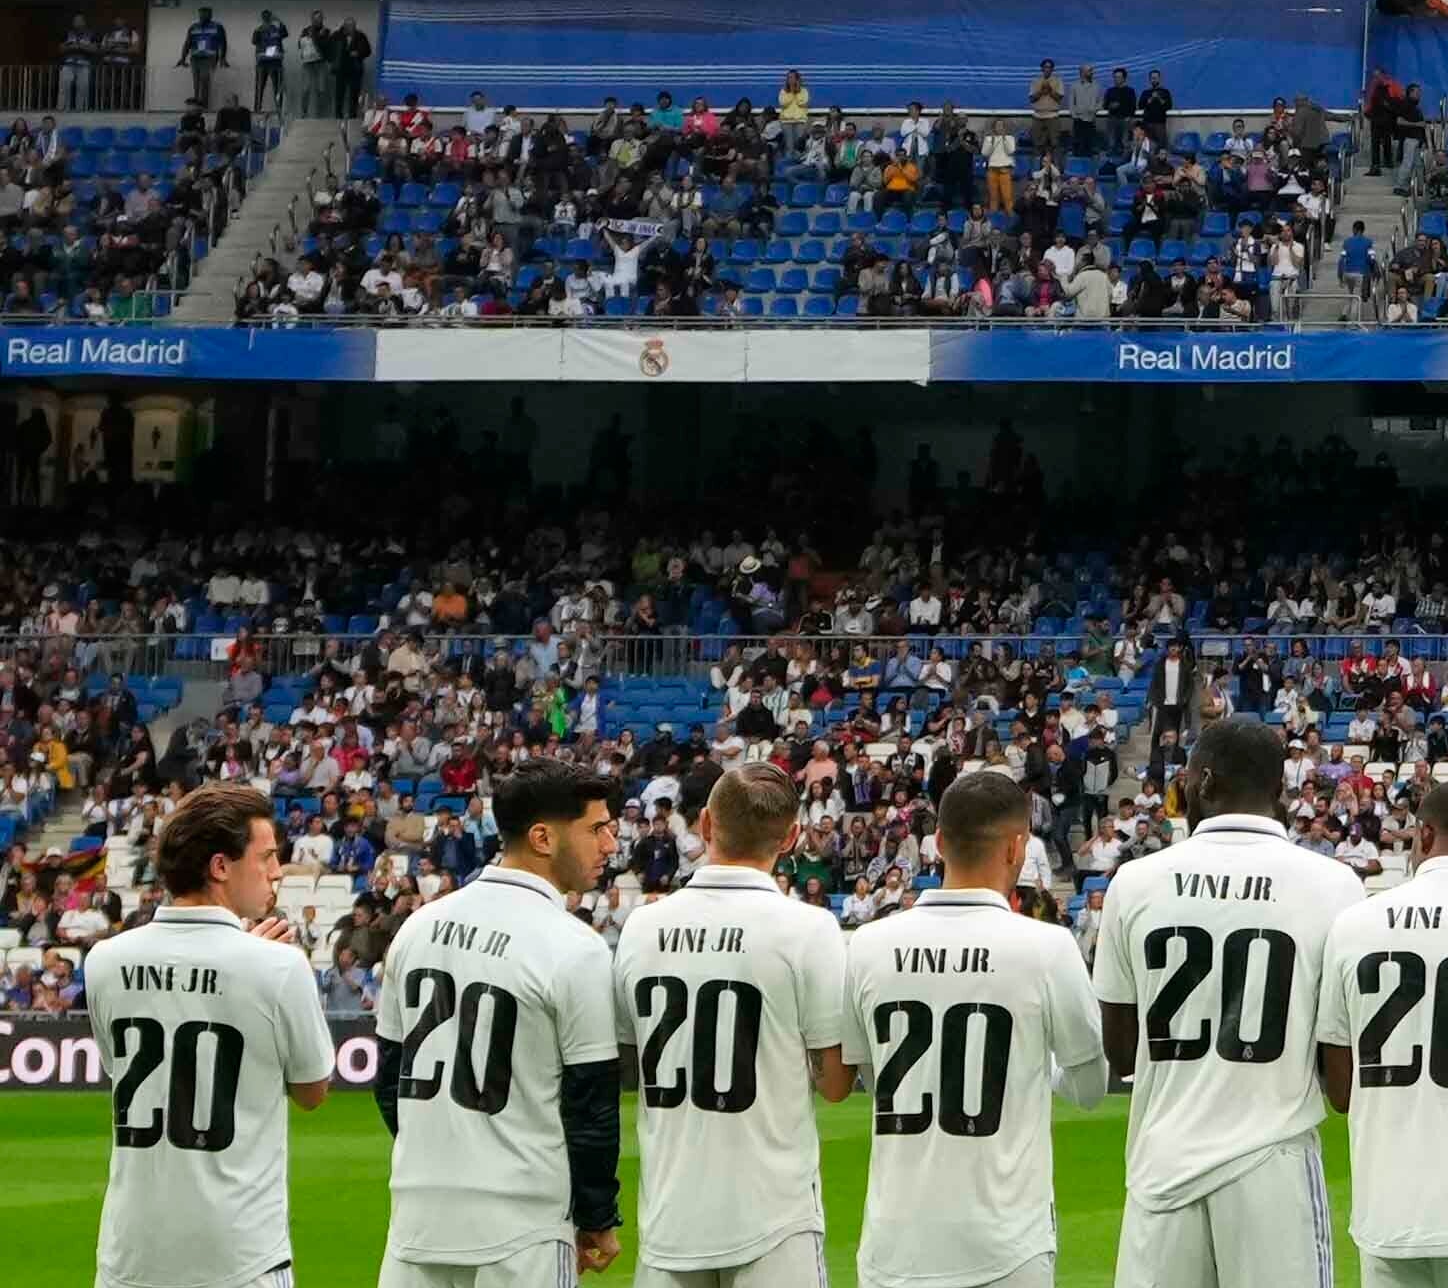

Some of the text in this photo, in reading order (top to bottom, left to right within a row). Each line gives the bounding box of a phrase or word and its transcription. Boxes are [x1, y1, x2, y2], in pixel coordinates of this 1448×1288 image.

[8, 339, 183, 363] Real Madrid
[1120, 344, 1290, 369] Real Madrid
[1176, 873, 1276, 902] VINI JR.
[1388, 907, 1441, 929] VINI
[432, 921, 509, 961] VINI JR.
[659, 927, 746, 954] VINI JR.
[895, 947, 995, 973] VINI JR.
[121, 966, 223, 995] VINI JR.
[1144, 926, 1296, 1063] 20
[0, 1019, 102, 1084] on
[399, 968, 517, 1115] 20
[635, 976, 763, 1113] 20
[111, 1017, 245, 1152] 20
[873, 1000, 1008, 1136] 20
